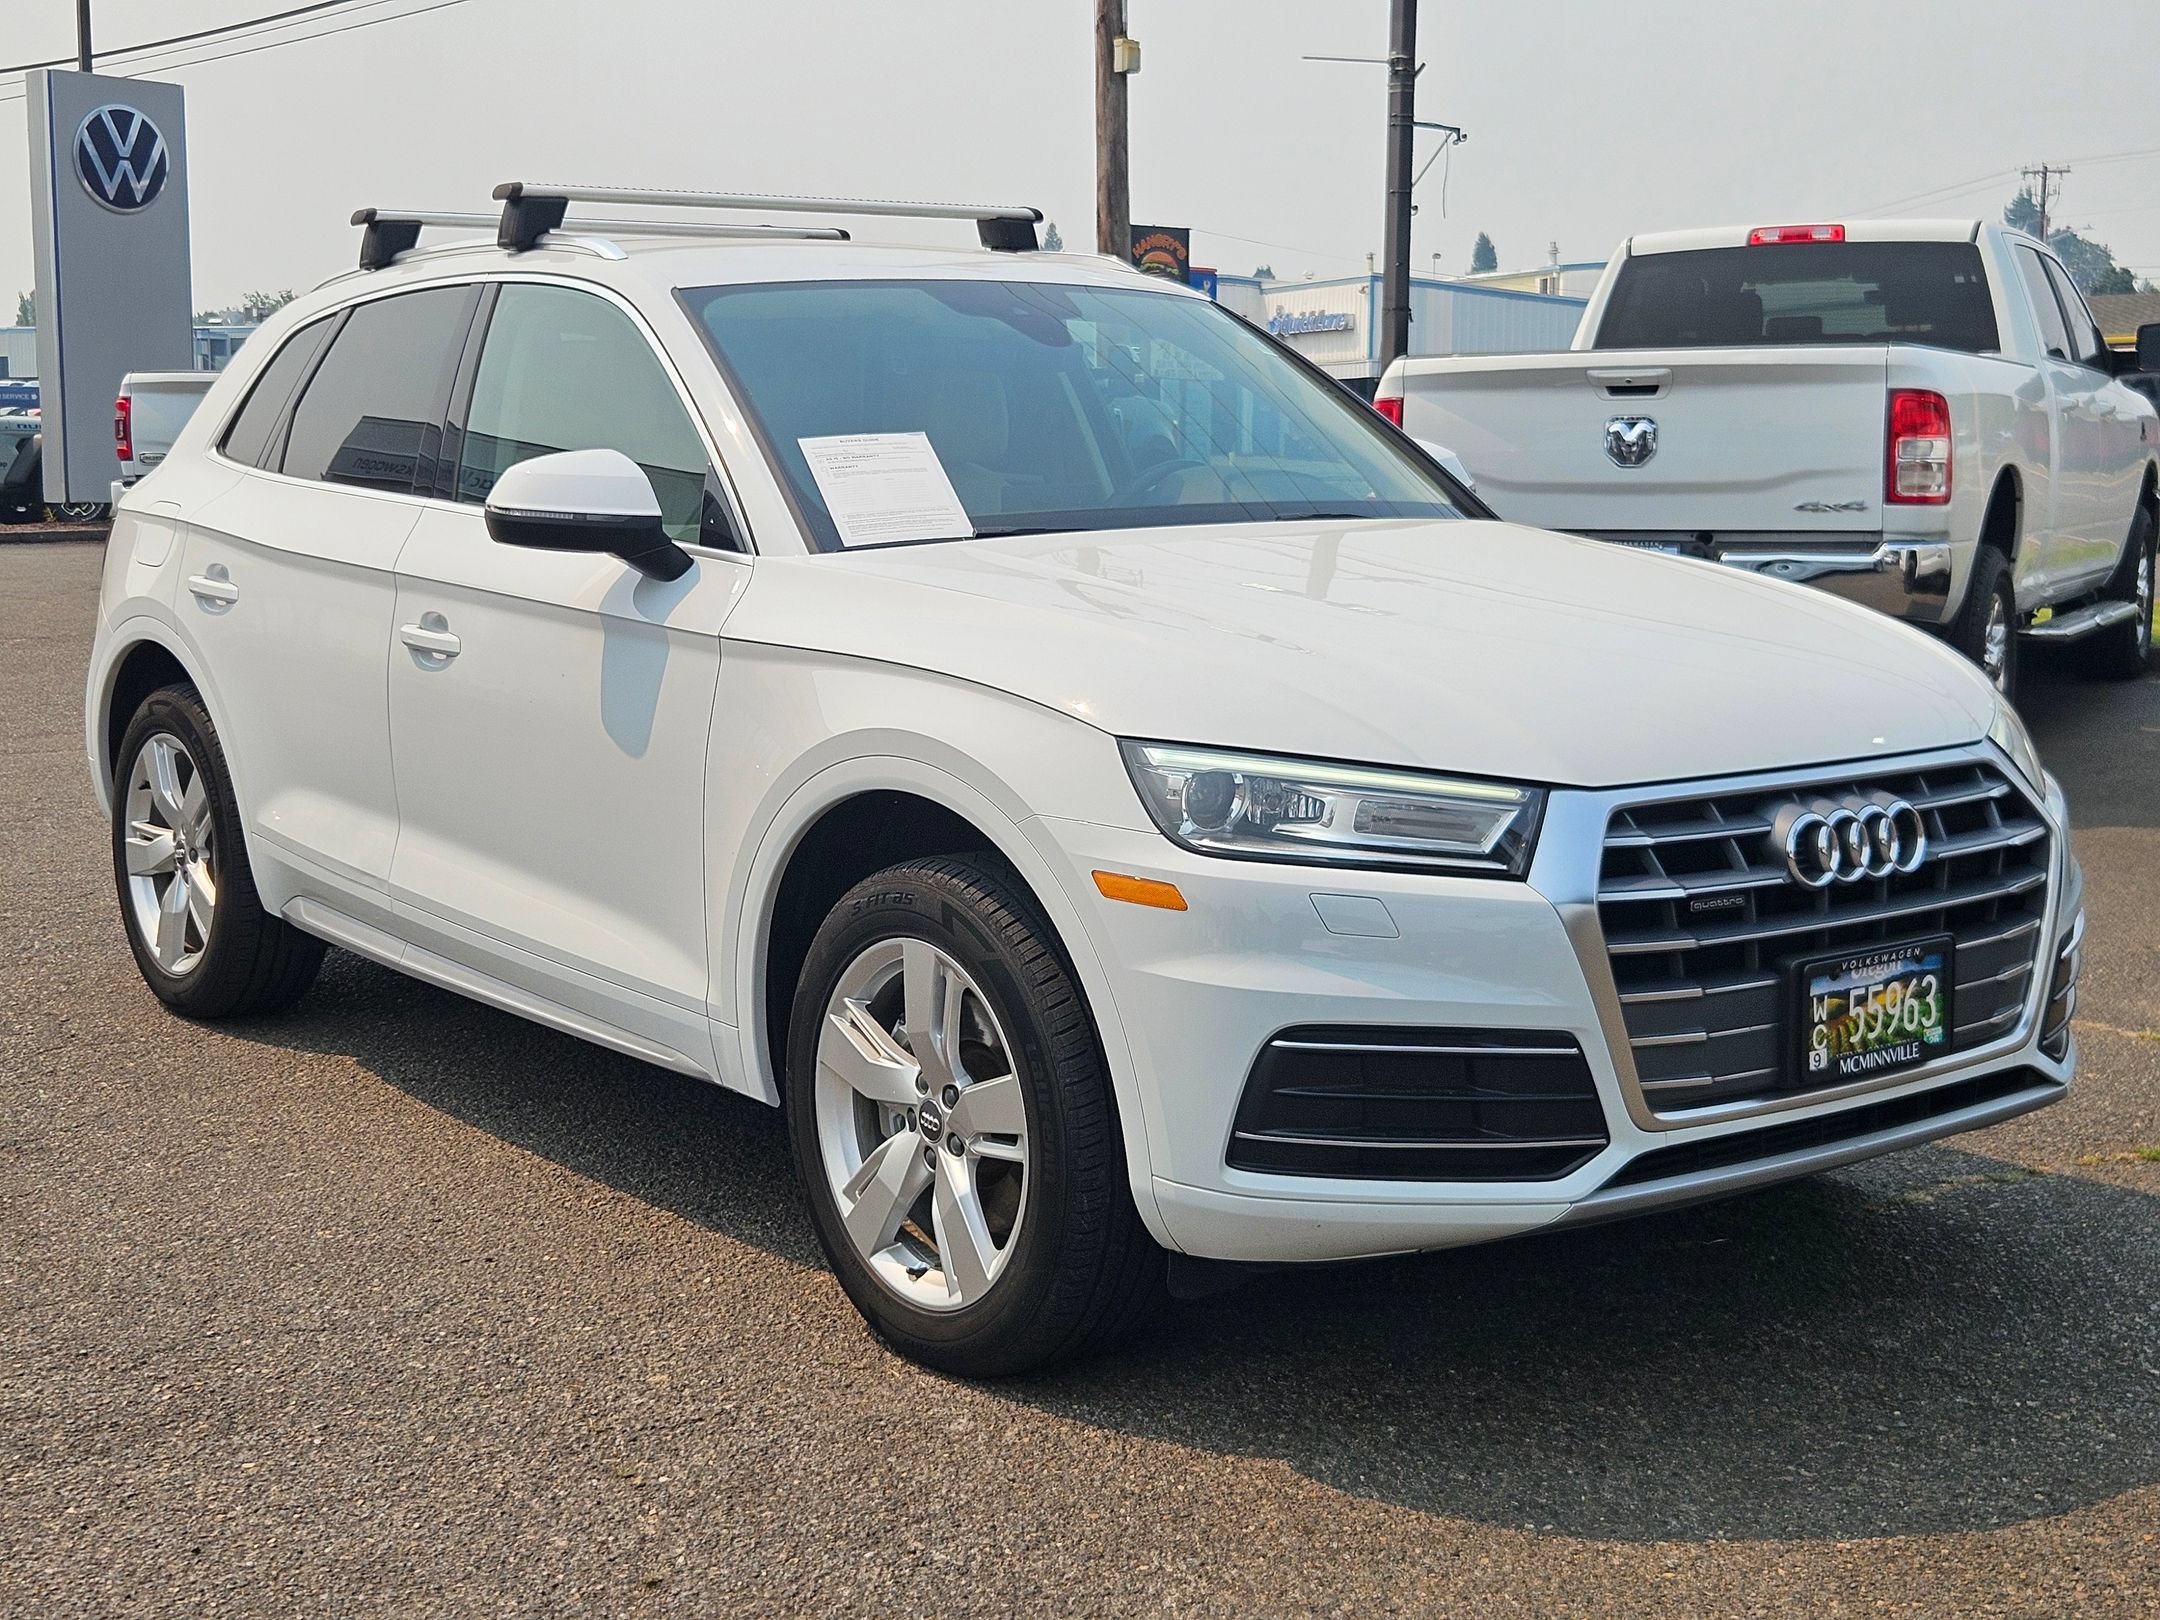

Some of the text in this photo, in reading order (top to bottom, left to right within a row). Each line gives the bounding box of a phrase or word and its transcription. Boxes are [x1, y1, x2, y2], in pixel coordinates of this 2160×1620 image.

[1693, 897, 1744, 911] quattro
[1841, 947, 1921, 970] VOLKSWAGEN
[1848, 974, 1938, 1043] 55963
[1813, 1054, 1822, 1068] 9
[1839, 1041, 1920, 1075] MCMINNVILLE
